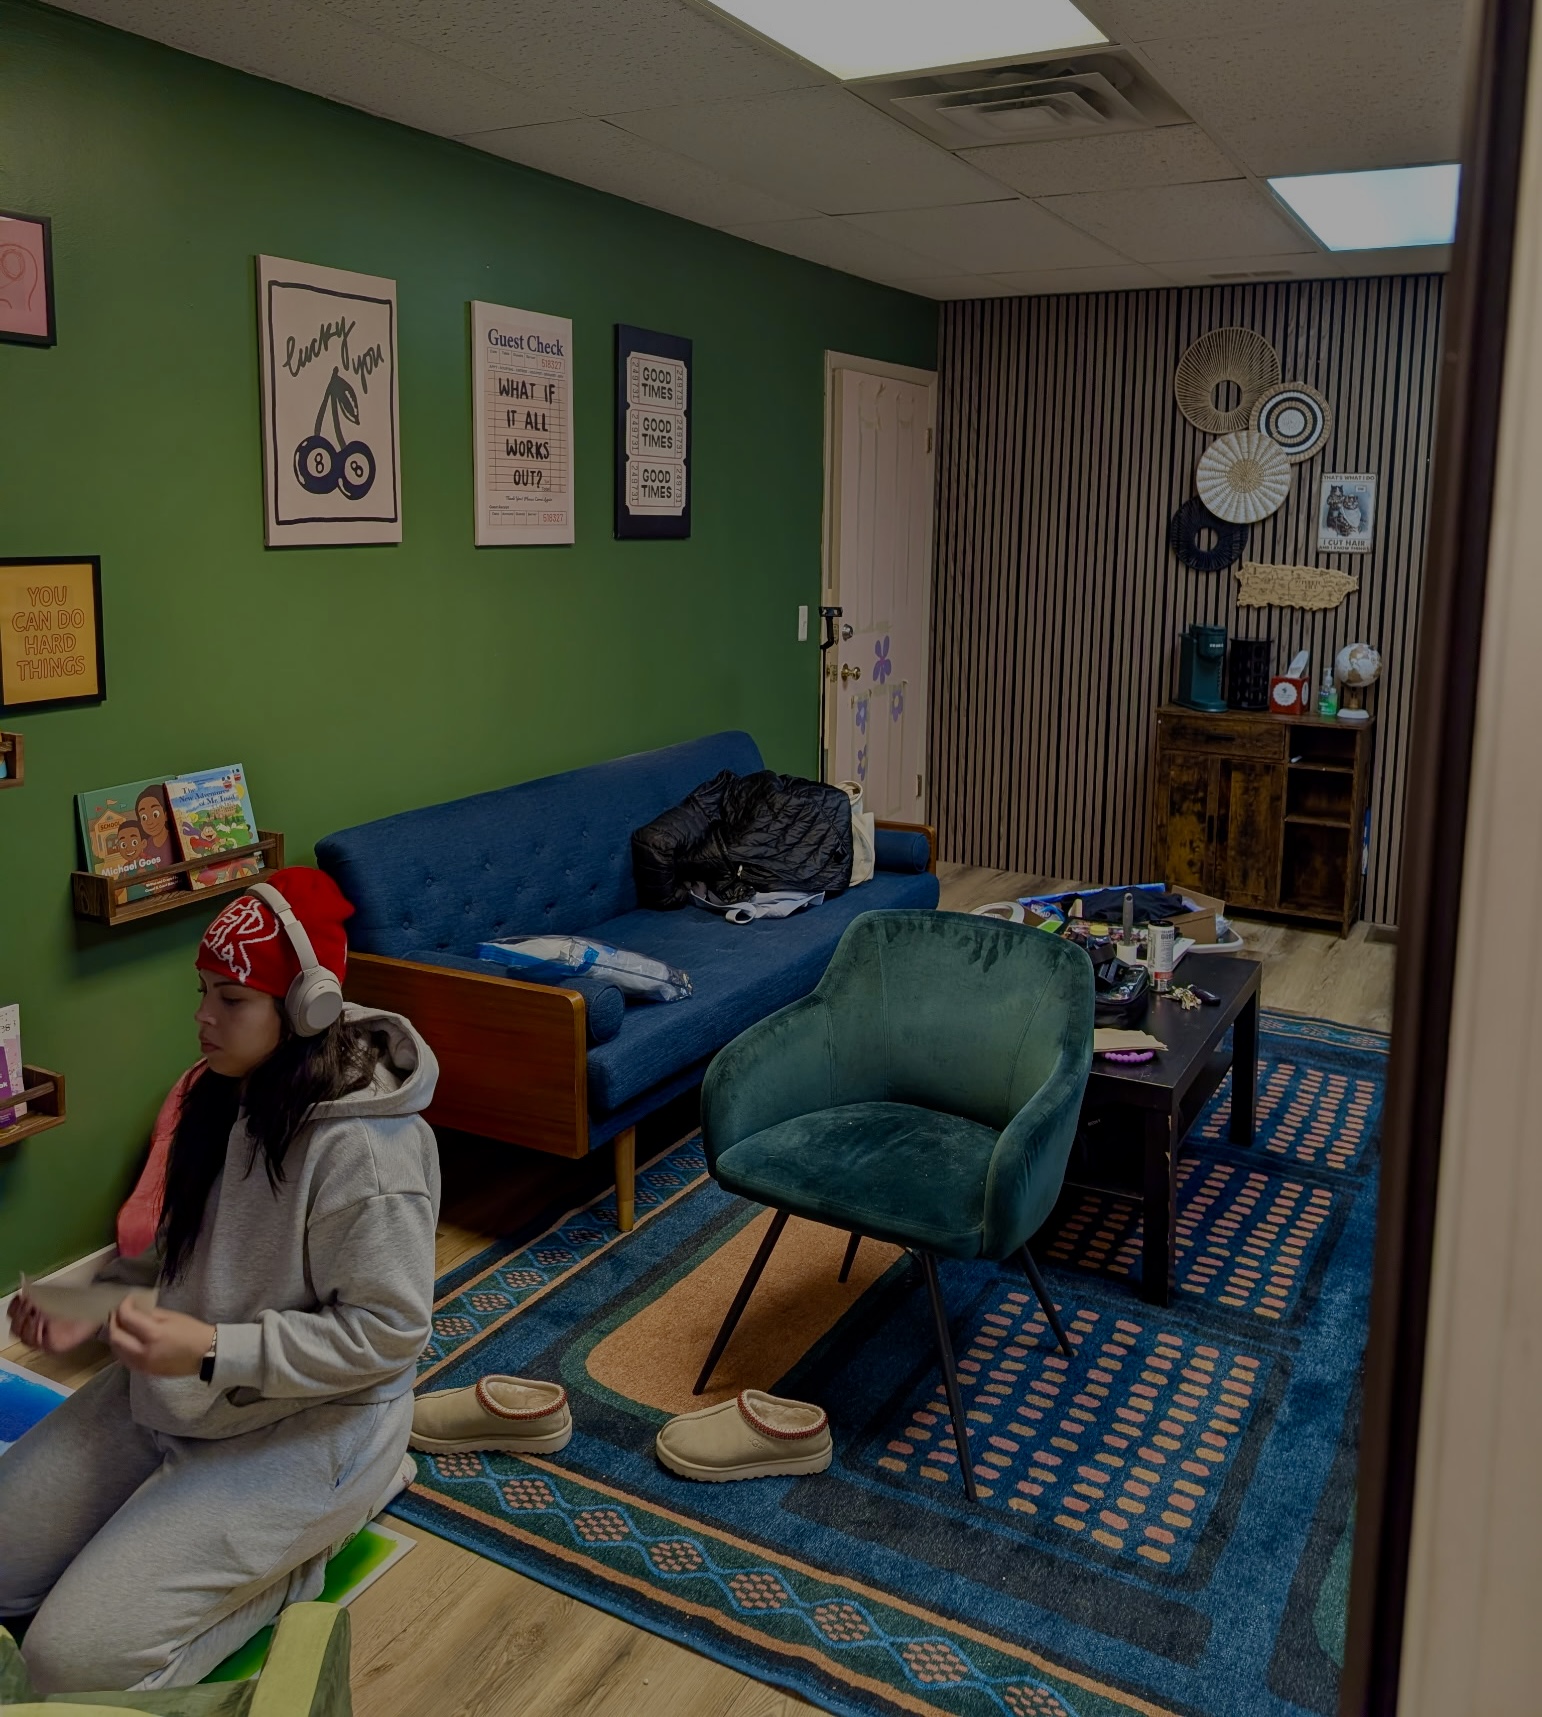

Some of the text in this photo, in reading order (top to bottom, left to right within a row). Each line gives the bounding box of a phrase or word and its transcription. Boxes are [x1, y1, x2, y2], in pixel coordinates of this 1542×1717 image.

[488, 328, 564, 357] Guest Check
[352, 344, 384, 394] you
[541, 359, 562, 370] 518327
[643, 367, 672, 385] GOOD
[499, 378, 555, 404] WHAT IF
[641, 383, 673, 400] TIMES
[507, 409, 548, 432] IT ALL
[643, 417, 672, 434] GOOD
[506, 438, 550, 460] WORKS
[641, 433, 673, 449] TIMES
[314, 452, 325, 474] 8
[350, 460, 363, 477] 8
[513, 469, 542, 488] OUT?
[642, 469, 671, 483] GOOD
[641, 485, 672, 499] TIMES
[543, 514, 564, 523] 518327
[27, 586, 67, 607] YOU
[12, 608, 84, 632] CAN DO
[24, 633, 76, 655] HARD
[16, 656, 85, 681] THINGS
[195, 789, 230, 799] Adventures
[101, 855, 162, 877] Michael Goes
